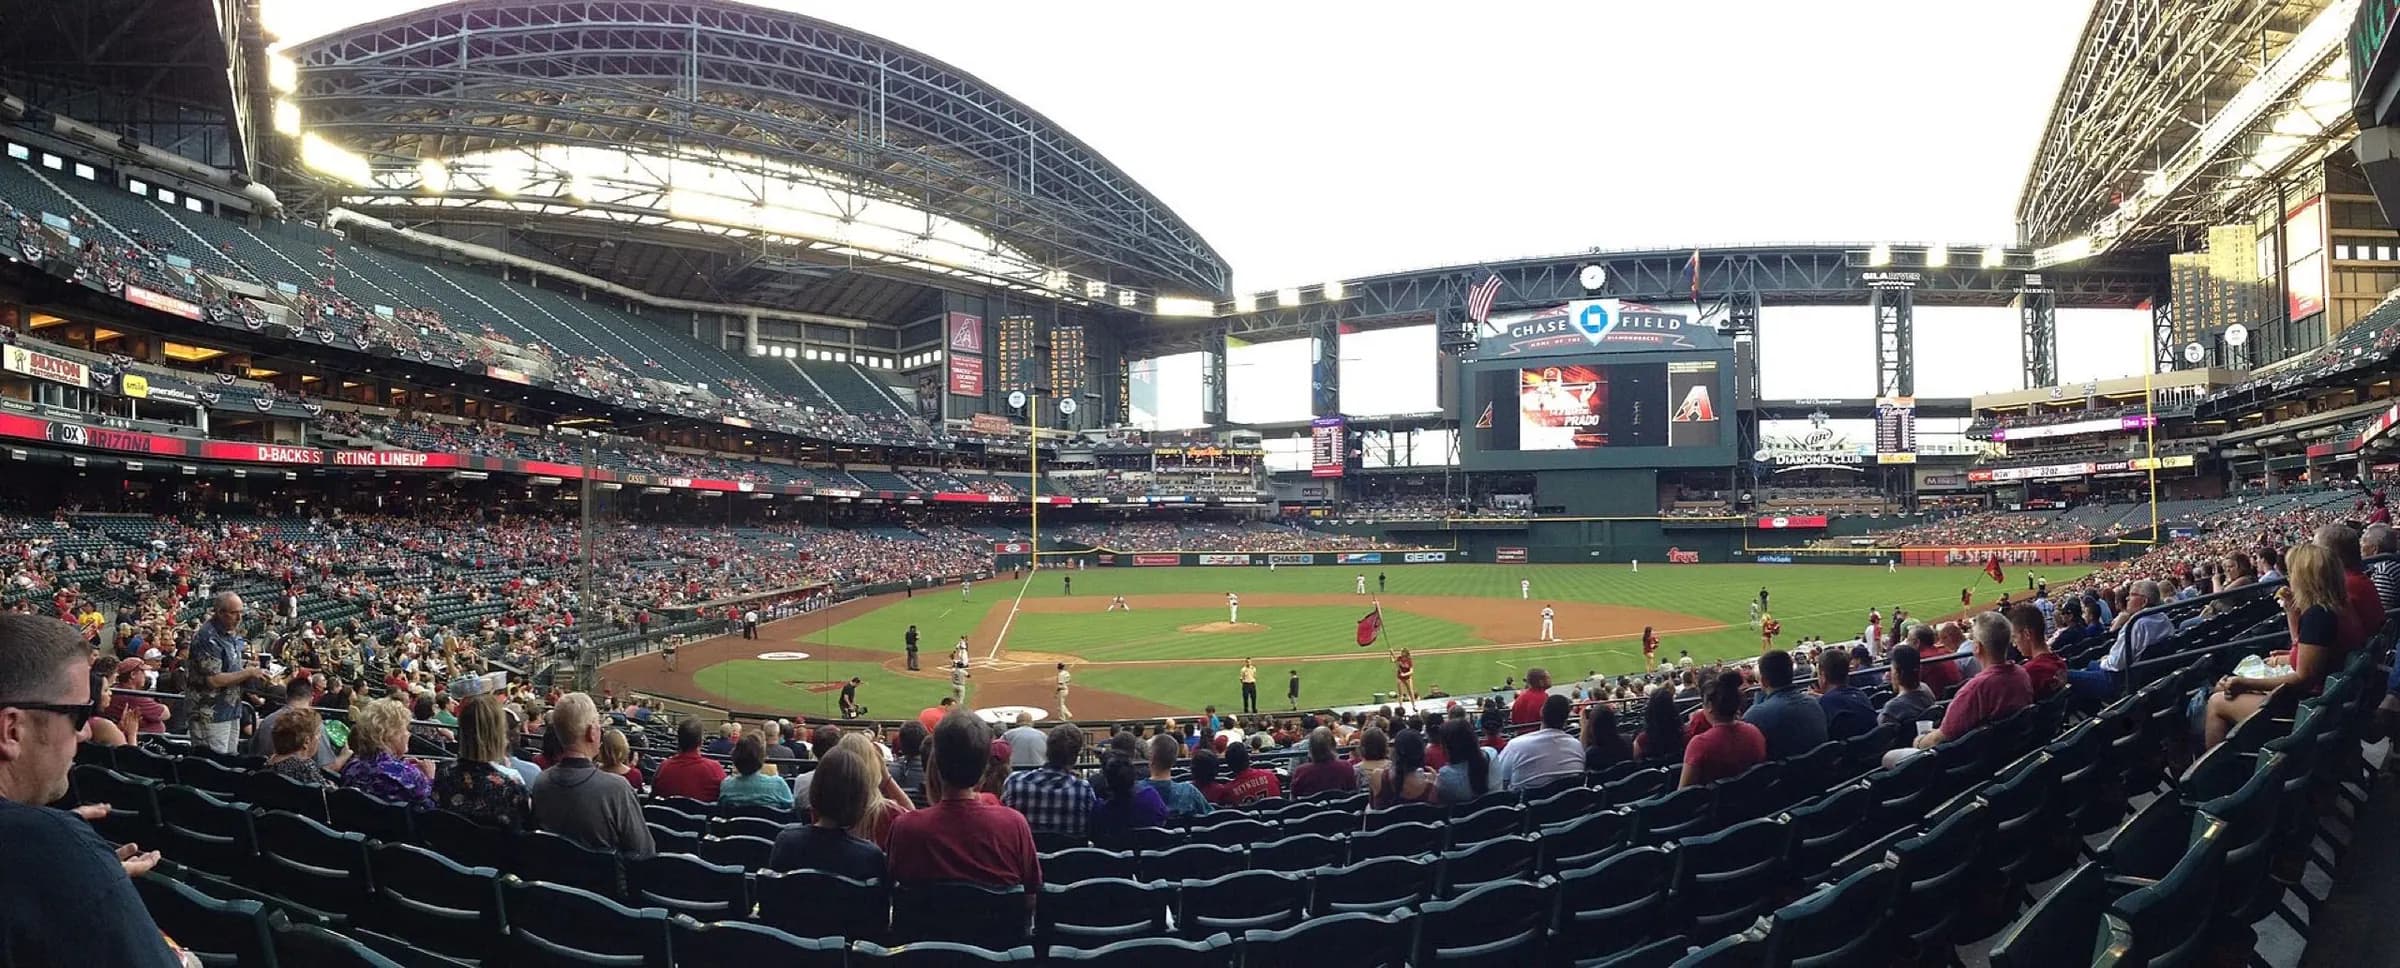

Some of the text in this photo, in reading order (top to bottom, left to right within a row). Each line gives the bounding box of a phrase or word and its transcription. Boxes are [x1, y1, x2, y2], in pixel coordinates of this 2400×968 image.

[1511, 315, 1681, 338] CHASE FIELD
[30, 353, 81, 378] SEXTON
[1564, 415, 1600, 426] PRADO
[89, 429, 151, 452] ARIZONA
[258, 447, 310, 463] D-BACKS
[381, 452, 428, 466] LINEUP
[1776, 453, 1862, 465] DIAMOND CLUB
[1272, 555, 1301, 563] CHASE
[1404, 553, 1446, 562] GEICO
[2002, 546, 2037, 563] Farm
[1233, 775, 1269, 796] REYNOLDS
